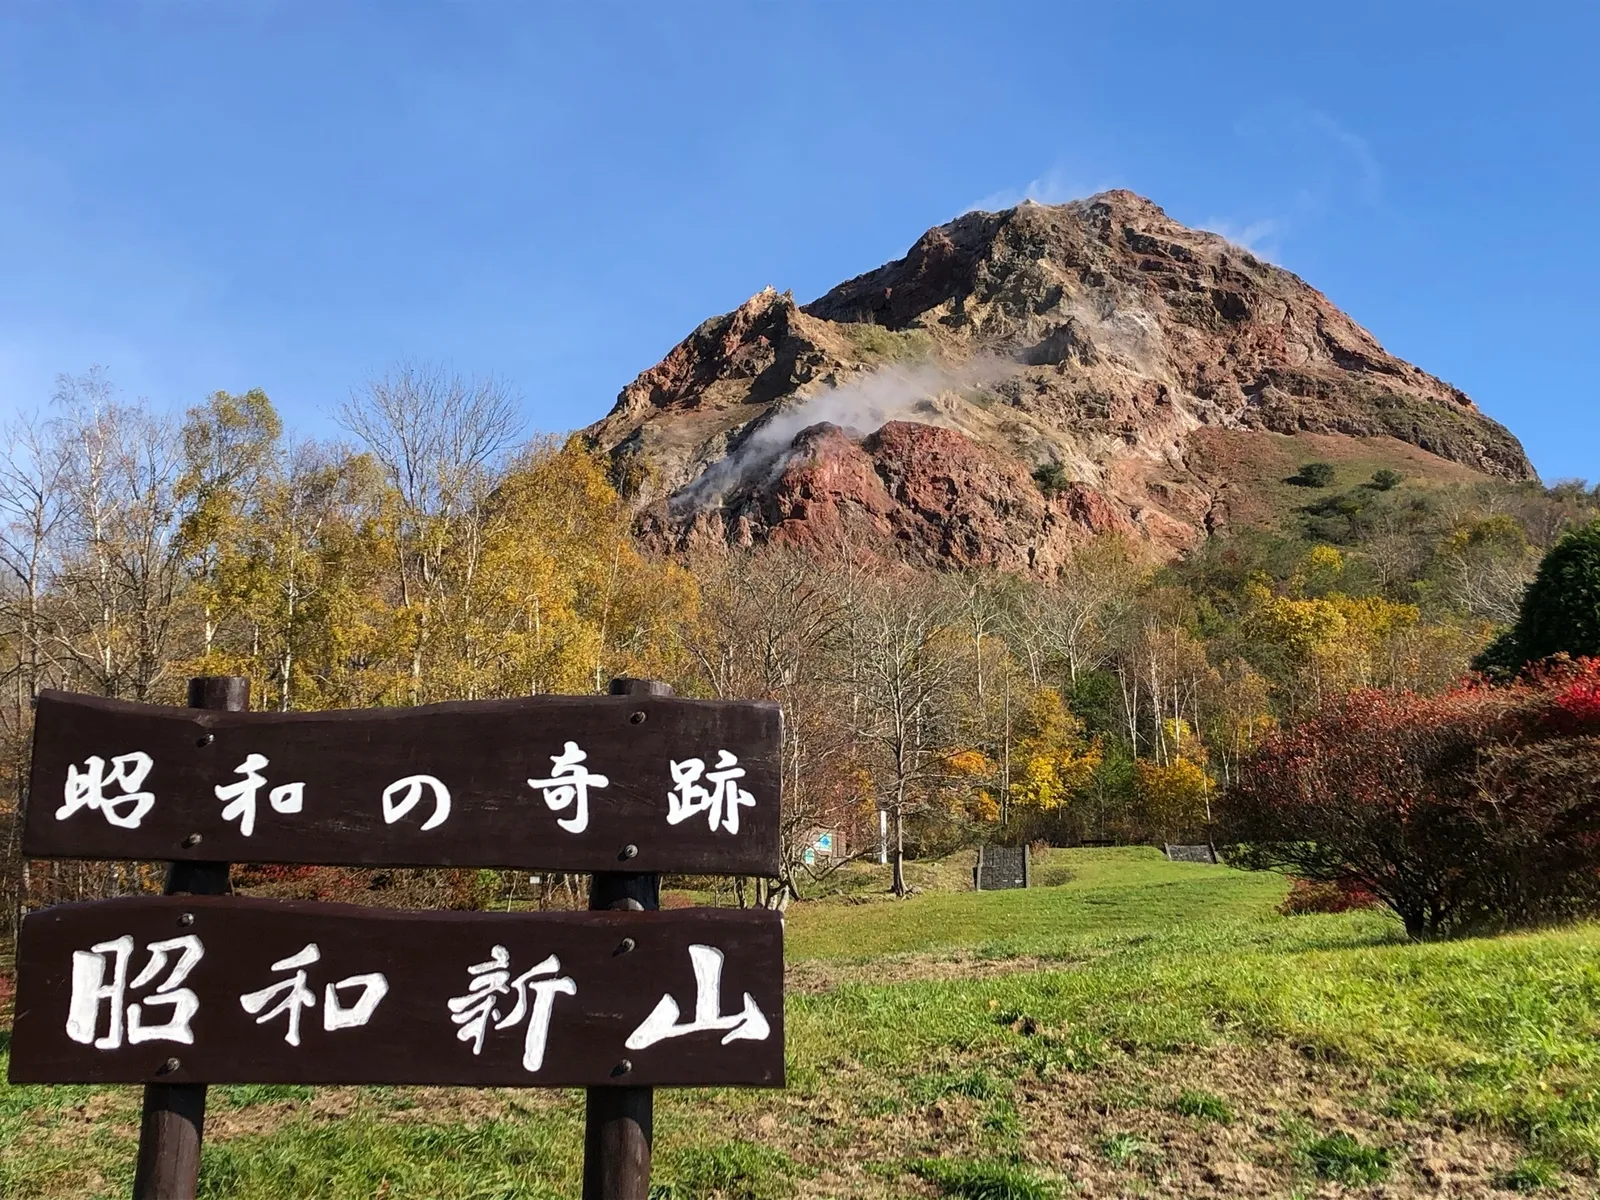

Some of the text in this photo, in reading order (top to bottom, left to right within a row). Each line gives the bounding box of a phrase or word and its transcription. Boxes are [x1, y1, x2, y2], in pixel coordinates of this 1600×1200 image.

[55, 740, 757, 836] 昭和の奇跡
[65, 934, 771, 1072] 昭和新山
